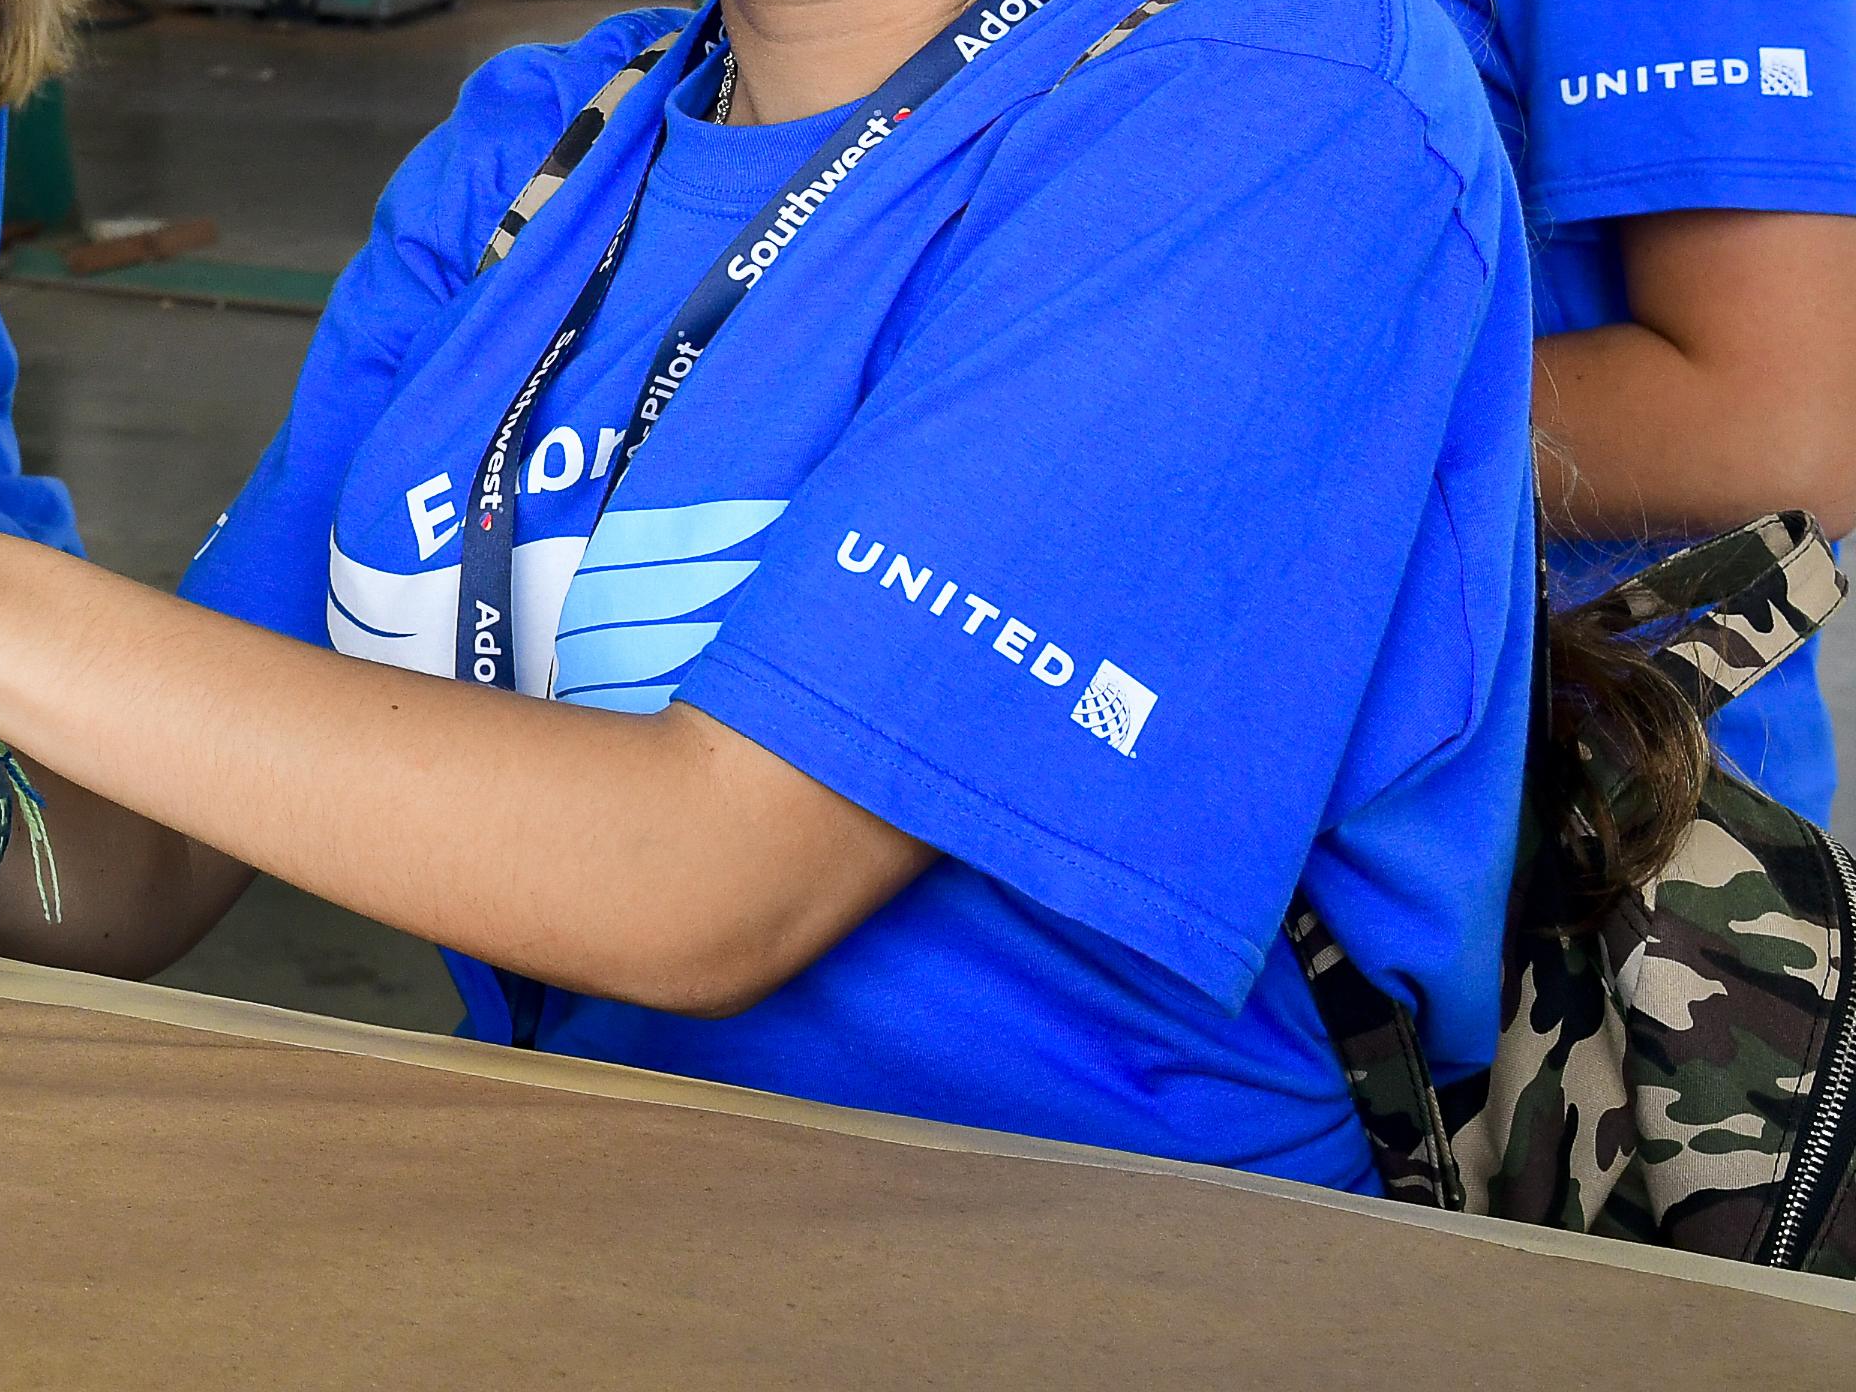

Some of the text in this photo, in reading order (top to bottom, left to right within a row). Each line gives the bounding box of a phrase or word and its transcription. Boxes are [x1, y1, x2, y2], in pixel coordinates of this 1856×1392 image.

[1559, 58, 1749, 105] UNITED
[727, 115, 893, 290] Southwest
[480, 328, 575, 510] Southwest
[836, 530, 1075, 687] UNITED
